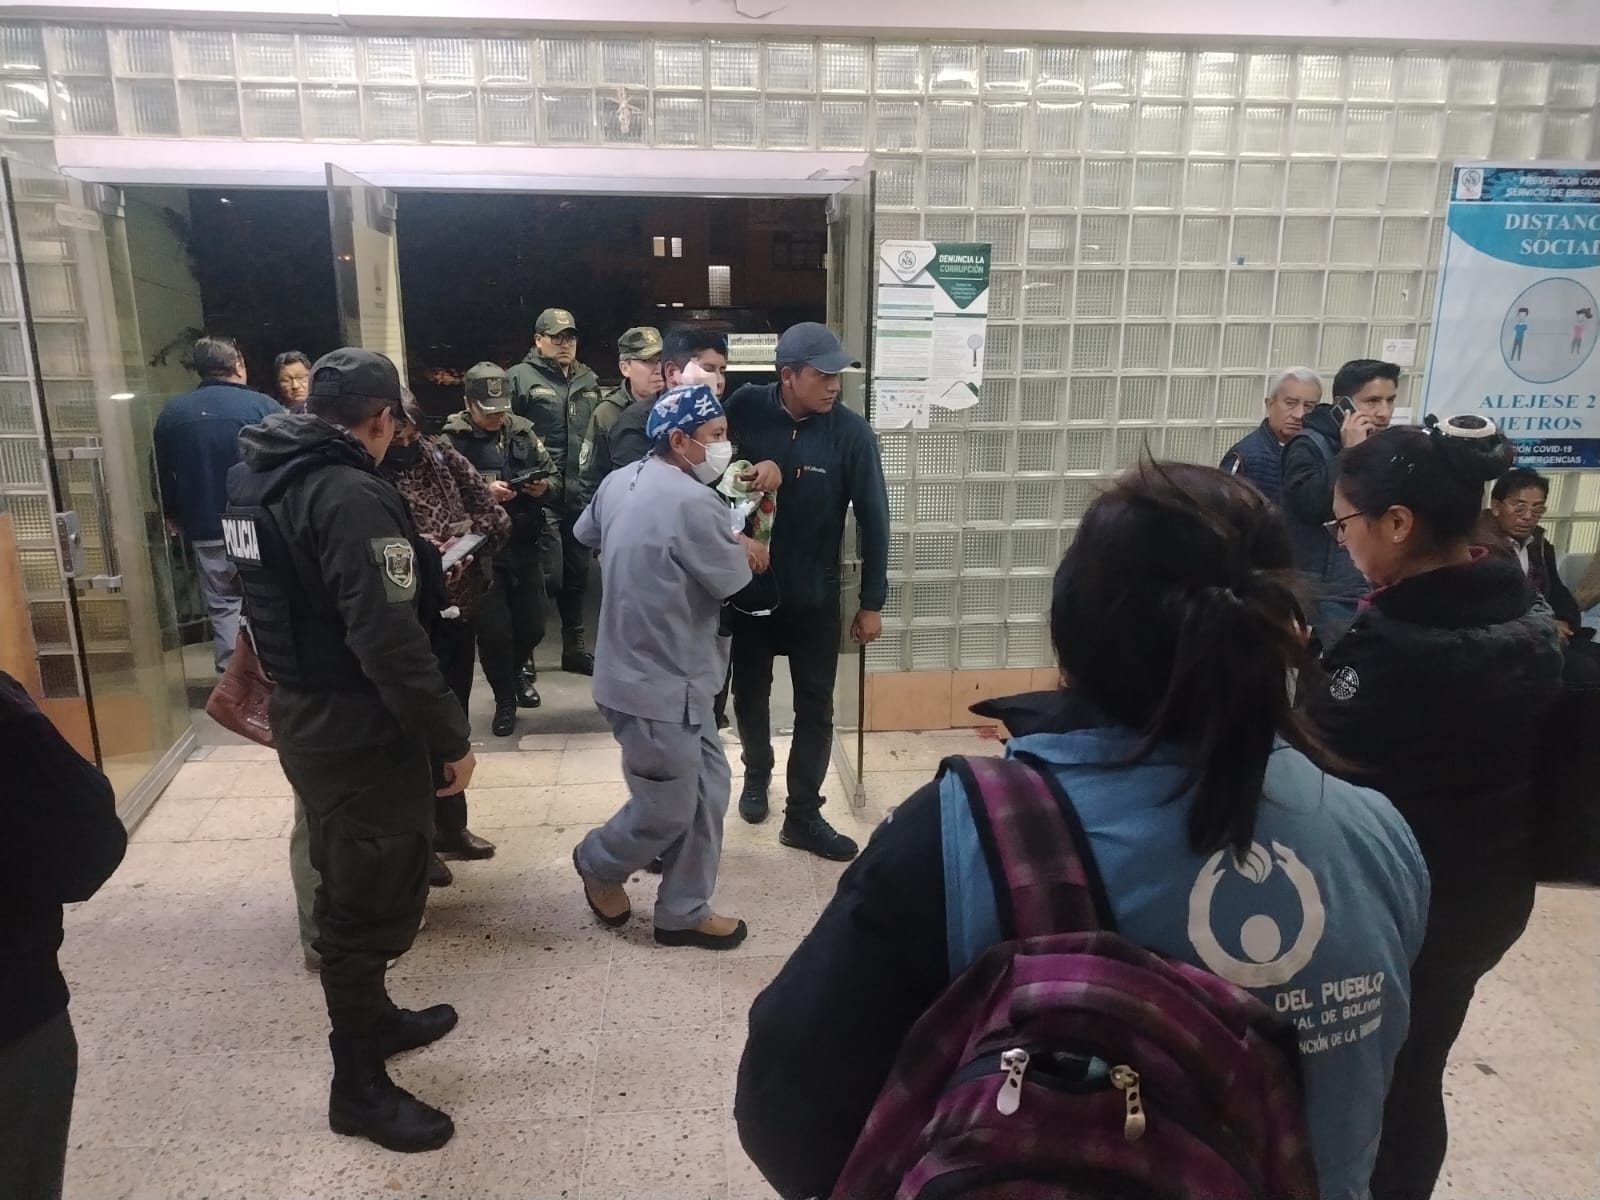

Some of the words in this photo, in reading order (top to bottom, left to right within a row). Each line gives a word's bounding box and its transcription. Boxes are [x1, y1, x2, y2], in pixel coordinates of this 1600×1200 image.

[1506, 187, 1549, 197] SERVICIO
[1551, 188, 1564, 197] DE
[1504, 213, 1600, 231] DISTANC
[939, 254, 974, 264] DENUNCIA
[975, 256, 985, 264] LA
[940, 264, 984, 274] CORRUPCIÓN
[1480, 394, 1579, 408] ALEJESE
[1586, 394, 1596, 408] 2
[1533, 445, 1573, 453] COVID-19
[1518, 456, 1582, 464] EMERGENCIAS
[221, 519, 261, 561] POLICIA
[1275, 988, 1314, 1013] DEL
[1321, 971, 1384, 1006] PUEBLO
[1293, 1016, 1315, 1030] AL
[1321, 1009, 1338, 1025] DE
[1342, 997, 1381, 1020] BOLIVIA
[1331, 1031, 1343, 1047] DE
[1344, 1028, 1357, 1043] LA
